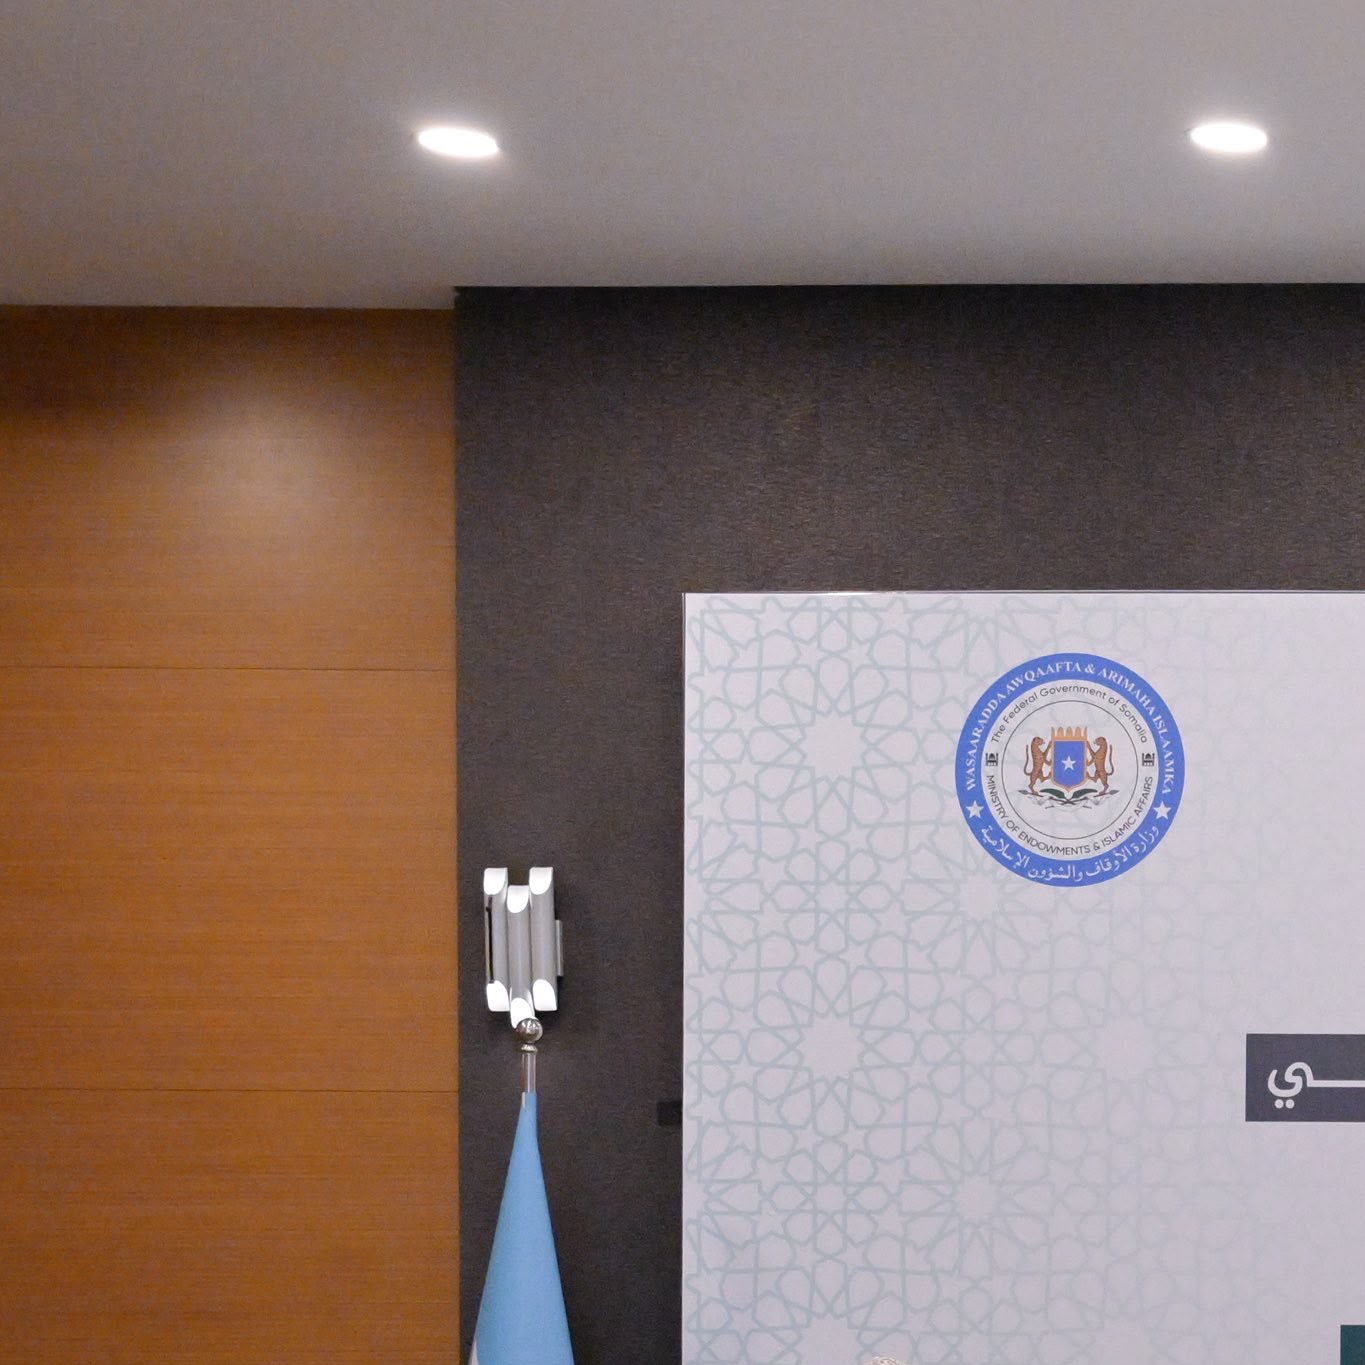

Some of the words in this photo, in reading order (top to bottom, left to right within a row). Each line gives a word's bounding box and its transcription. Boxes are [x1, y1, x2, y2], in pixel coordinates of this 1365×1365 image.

[965, 691, 1007, 792] WASAARADDA
[1005, 661, 1082, 695] AWQAAFTA
[1084, 663, 1096, 675] &
[1098, 668, 1157, 716] ARIMAHA
[1152, 715, 1175, 795] ISLAAMKA
[991, 725, 1006, 744] The
[1003, 692, 1038, 724] Federal
[1039, 685, 1107, 700] Government
[1108, 697, 1120, 706] of
[1119, 703, 1148, 744] Somalia
[986, 775, 1008, 819] MINISTRY
[1006, 820, 1020, 833] OF
[1018, 831, 1091, 856] ENDOWMENTS
[1093, 842, 1100, 851] &
[1101, 816, 1136, 846] ISLAMIC
[1133, 776, 1153, 817] AFFAIRS
